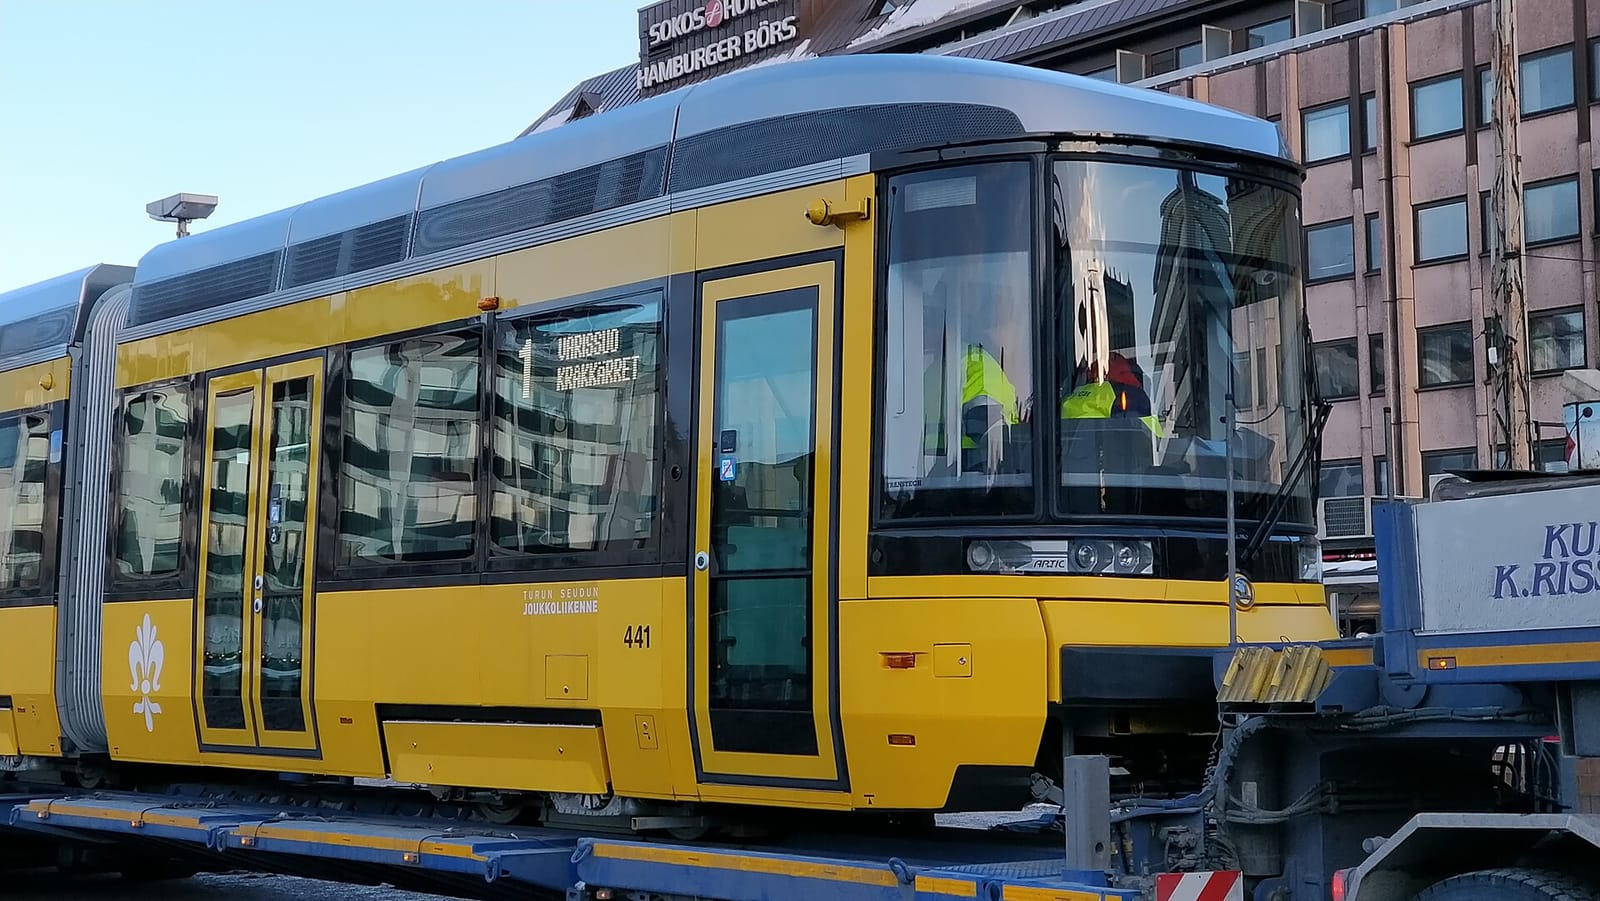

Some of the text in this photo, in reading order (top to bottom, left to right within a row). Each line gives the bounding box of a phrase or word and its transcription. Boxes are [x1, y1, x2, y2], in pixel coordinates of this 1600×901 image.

[650, 7, 706, 45] SOKOS
[637, 15, 797, 90] HAMBURGER BÖRS
[518, 338, 532, 399] 1
[1543, 521, 1600, 560] KU
[1033, 557, 1065, 568] ARTIC
[1494, 559, 1600, 600] K.RIS
[523, 587, 599, 600] TURUN SEUDUN
[523, 600, 598, 616] JOUKKOLIIKENNE
[623, 625, 650, 649] 441
